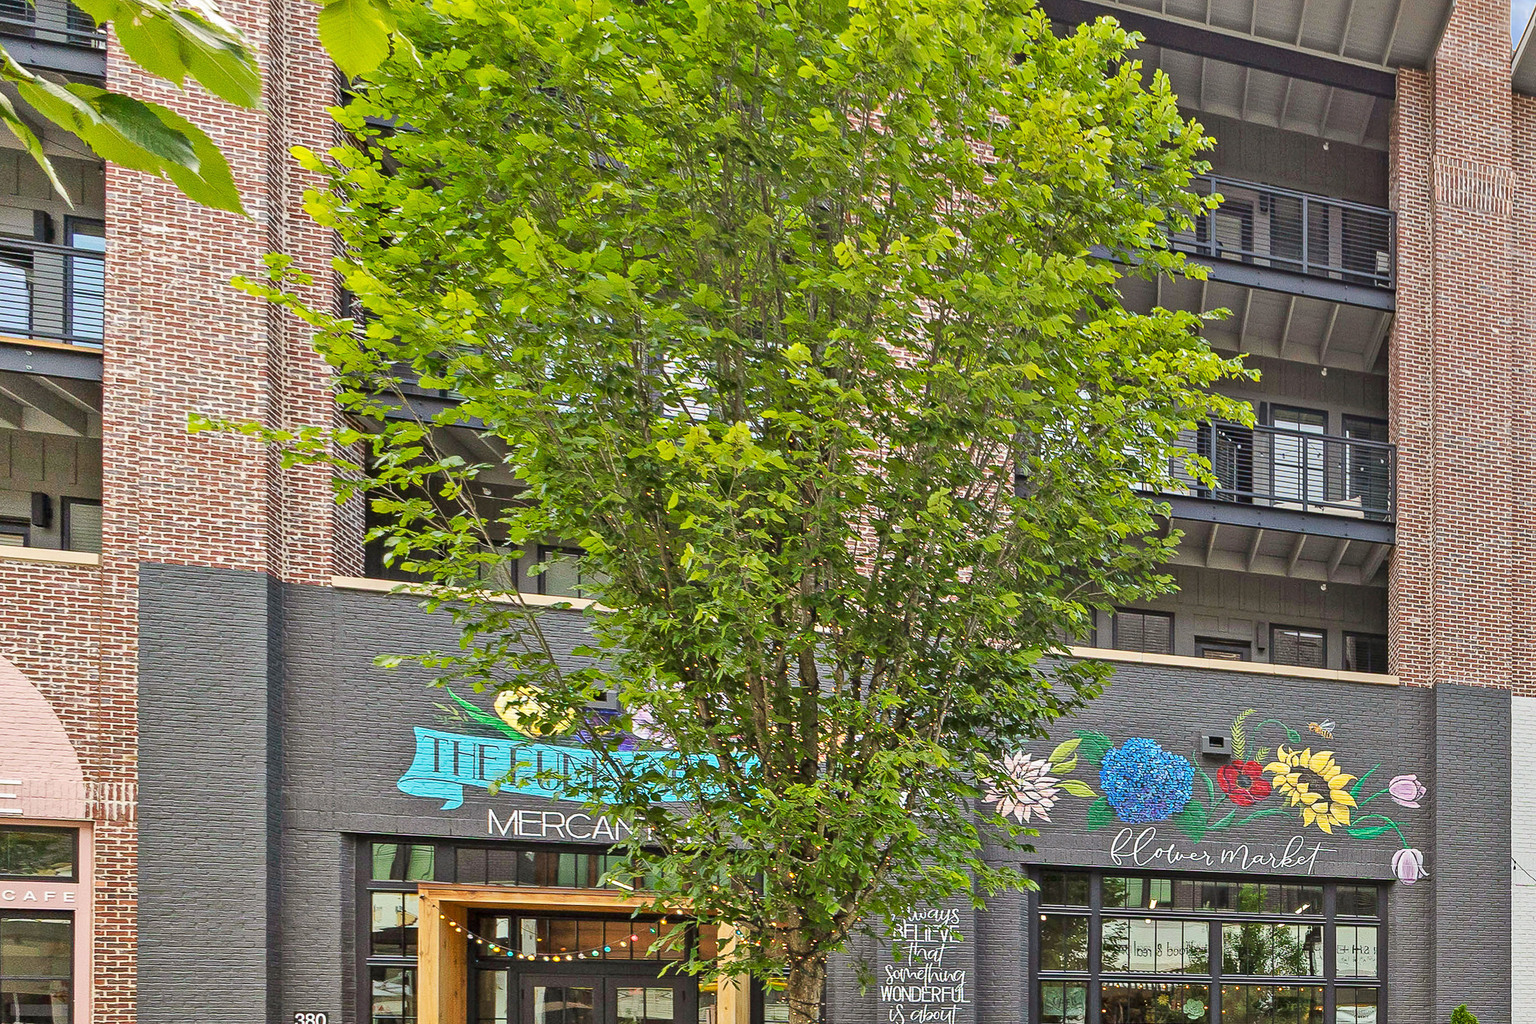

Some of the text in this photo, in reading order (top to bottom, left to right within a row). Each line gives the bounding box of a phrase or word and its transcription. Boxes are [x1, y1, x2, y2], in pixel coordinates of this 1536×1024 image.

[422, 735, 499, 783] THE
[1110, 826, 1215, 866] flower
[1, 889, 76, 903] CAFE
[902, 942, 957, 968] that
[884, 962, 968, 992] something
[880, 985, 971, 1003] WONDERFUL
